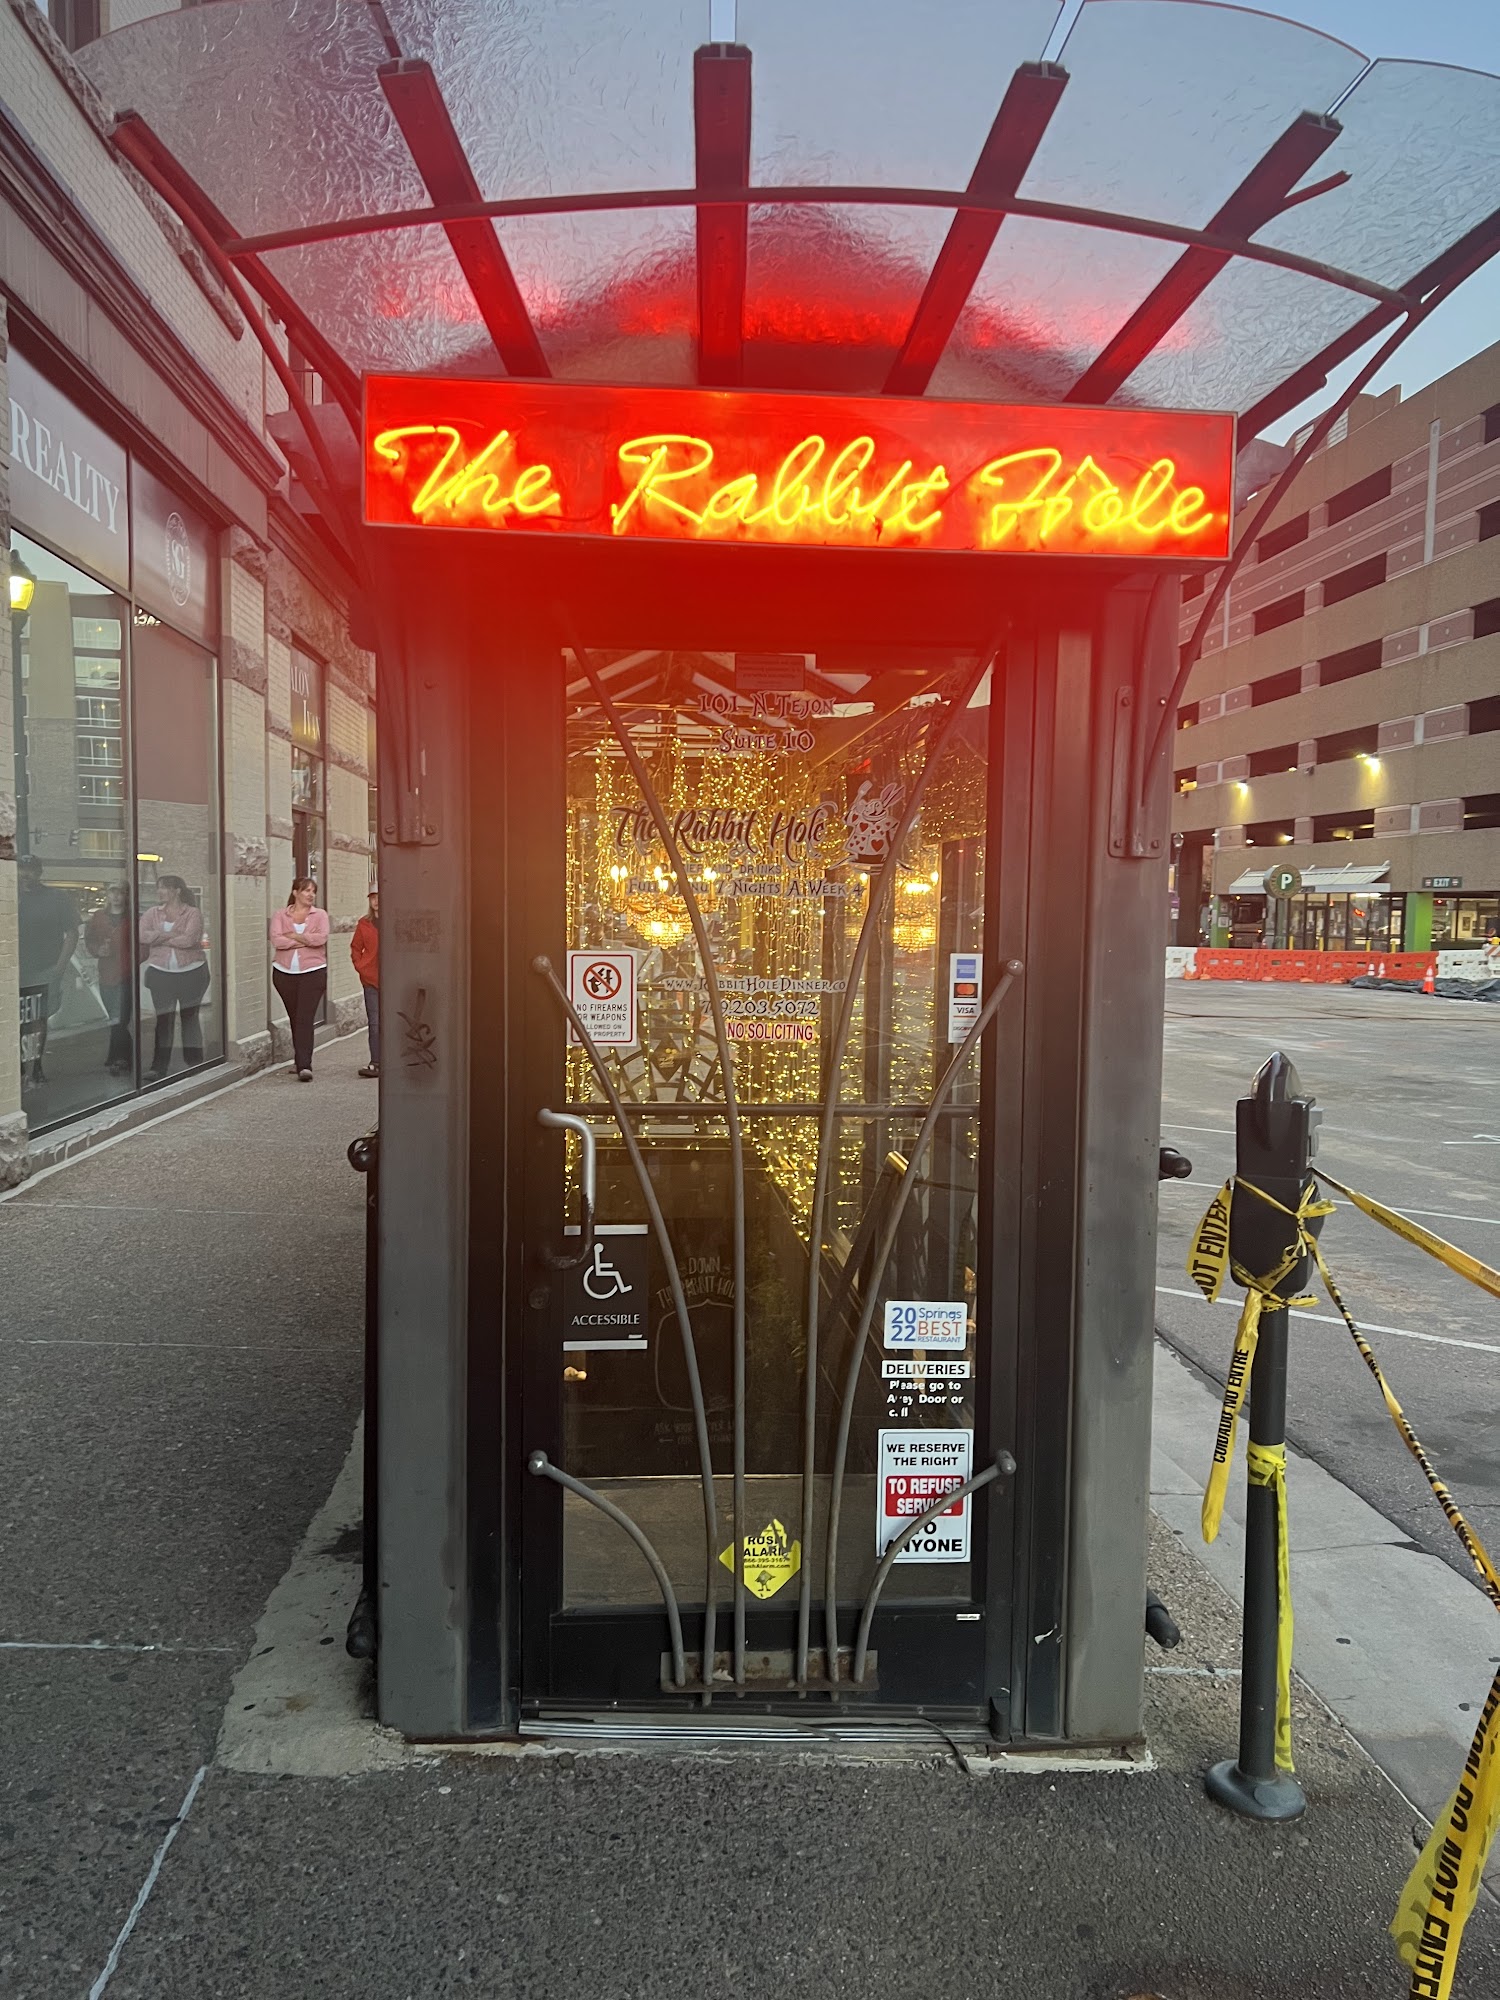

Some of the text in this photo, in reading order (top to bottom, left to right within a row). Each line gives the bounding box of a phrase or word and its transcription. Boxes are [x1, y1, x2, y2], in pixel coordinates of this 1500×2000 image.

[9, 398, 119, 534] REALTY
[374, 425, 1213, 540] The Rabbit Hole
[699, 694, 739, 714] 101
[752, 692, 768, 717] N
[786, 731, 814, 751] 10
[612, 804, 830, 865] The Rabbit Hole
[740, 864, 782, 875] DRINKS
[671, 880, 708, 893] MNU
[787, 880, 801, 896] A
[1281, 873, 1293, 890] P
[1433, 878, 1450, 887] EXIT
[576, 1004, 628, 1012] NO FIREARMS
[702, 1000, 819, 1016] 79.203.5072
[591, 1013, 627, 1021] WEAPONS
[727, 1023, 813, 1041] NO SOLICITING
[1195, 1198, 1228, 1259] ENTER
[571, 1314, 640, 1326] ACCESSIBLE
[891, 1307, 917, 1324] 20
[918, 1307, 962, 1322] Springs
[890, 1325, 916, 1342] 22
[918, 1321, 962, 1336] BEST
[886, 1364, 966, 1375] DELIVERIES
[890, 1380, 961, 1392] Please go to
[886, 1394, 964, 1405] Aey Door or
[1214, 1348, 1250, 1463] CUIDADO NO ENTRE
[888, 1407, 909, 1417] cll
[886, 1443, 965, 1453] WE RESERVE
[893, 1457, 959, 1466] THE RIGHT
[888, 1478, 962, 1495] TO REFUSE
[896, 1498, 952, 1514] SERVI
